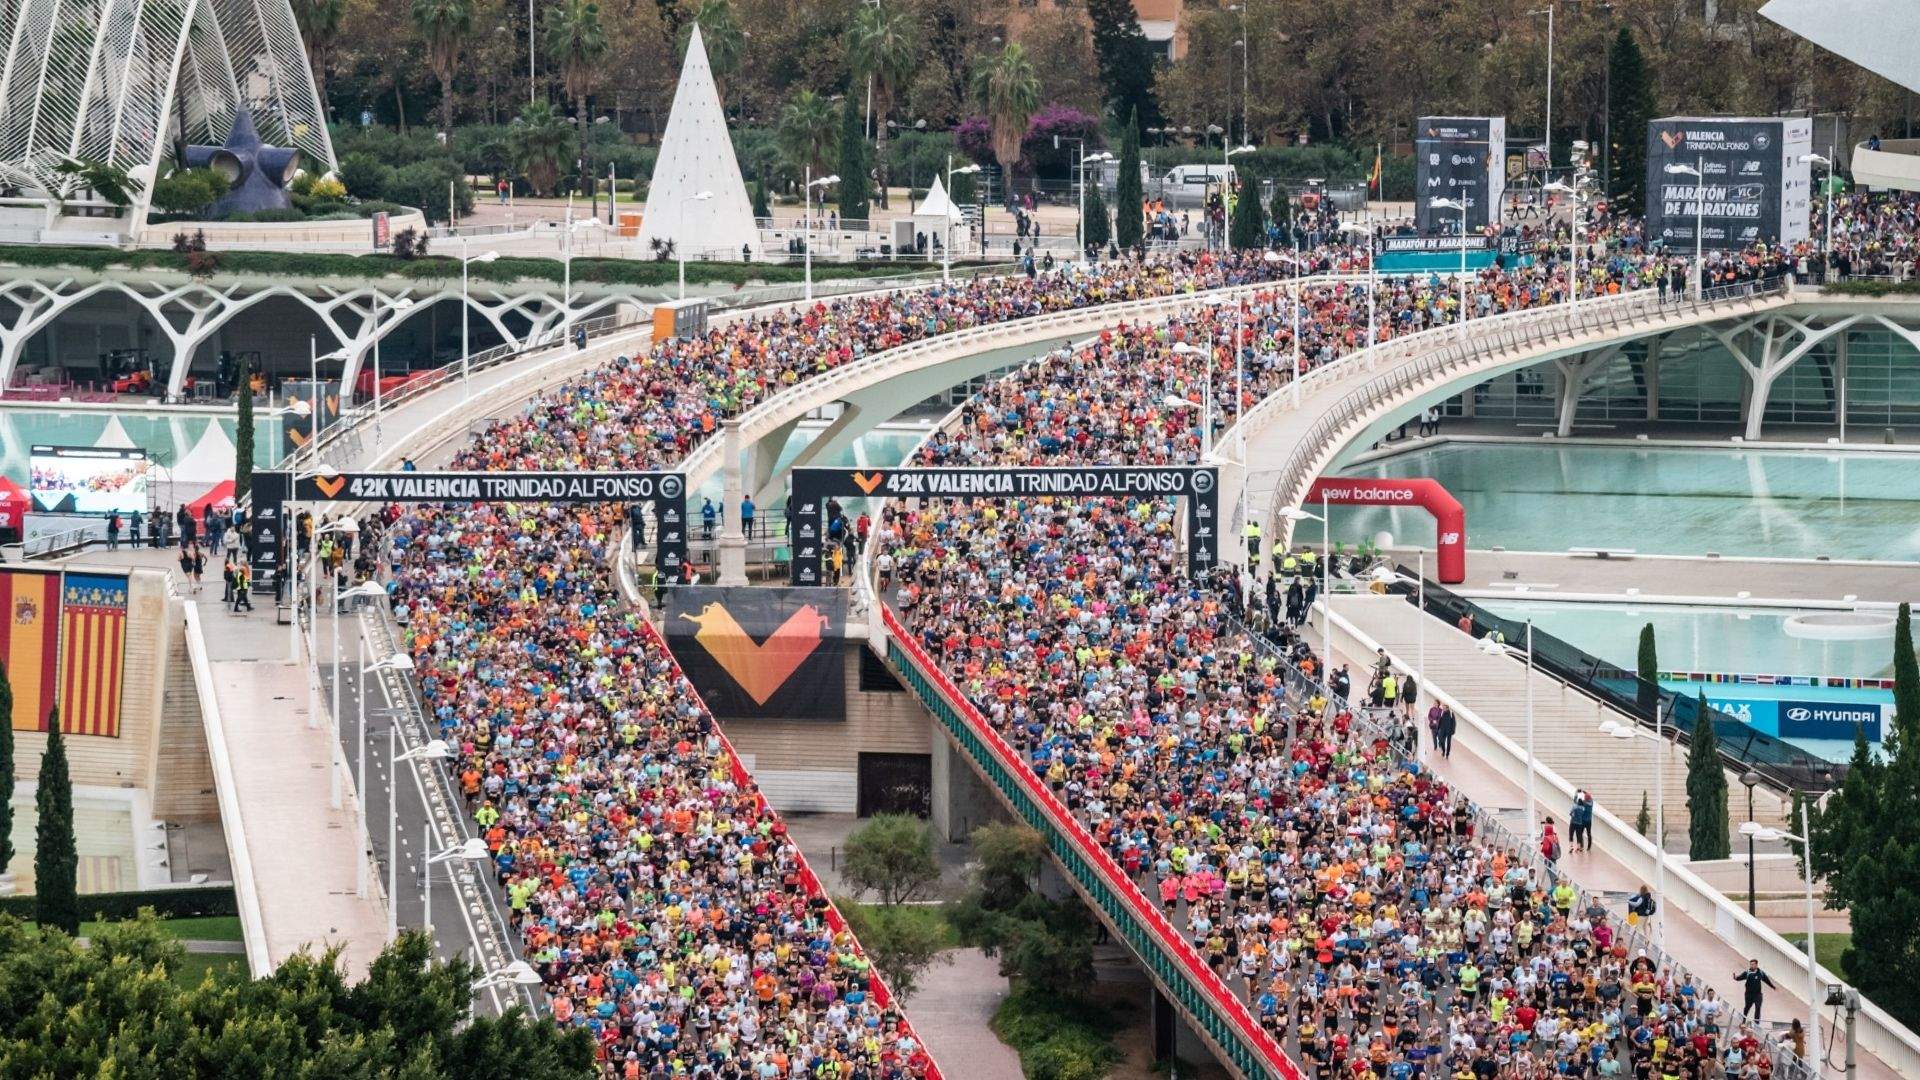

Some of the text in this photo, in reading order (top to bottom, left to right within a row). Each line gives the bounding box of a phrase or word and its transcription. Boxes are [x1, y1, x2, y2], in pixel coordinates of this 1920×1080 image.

[1686, 131, 1724, 141] VALENCIA
[1685, 141, 1750, 151] TRINIDAD ALFONSO
[1664, 184, 1726, 201] MARATÓN
[1665, 202, 1760, 217] DE MARATONES
[1388, 239, 1426, 249] MARATÓN
[1427, 239, 1438, 247] DE
[349, 477, 653, 498] 42K VALENCIA TRINIDAD ALFONSO
[886, 471, 1185, 493] 42K VALENCIA TRINIDAD ALFONSO
[1322, 487, 1414, 500] new balance
[1813, 709, 1875, 722] HYUNDAI
